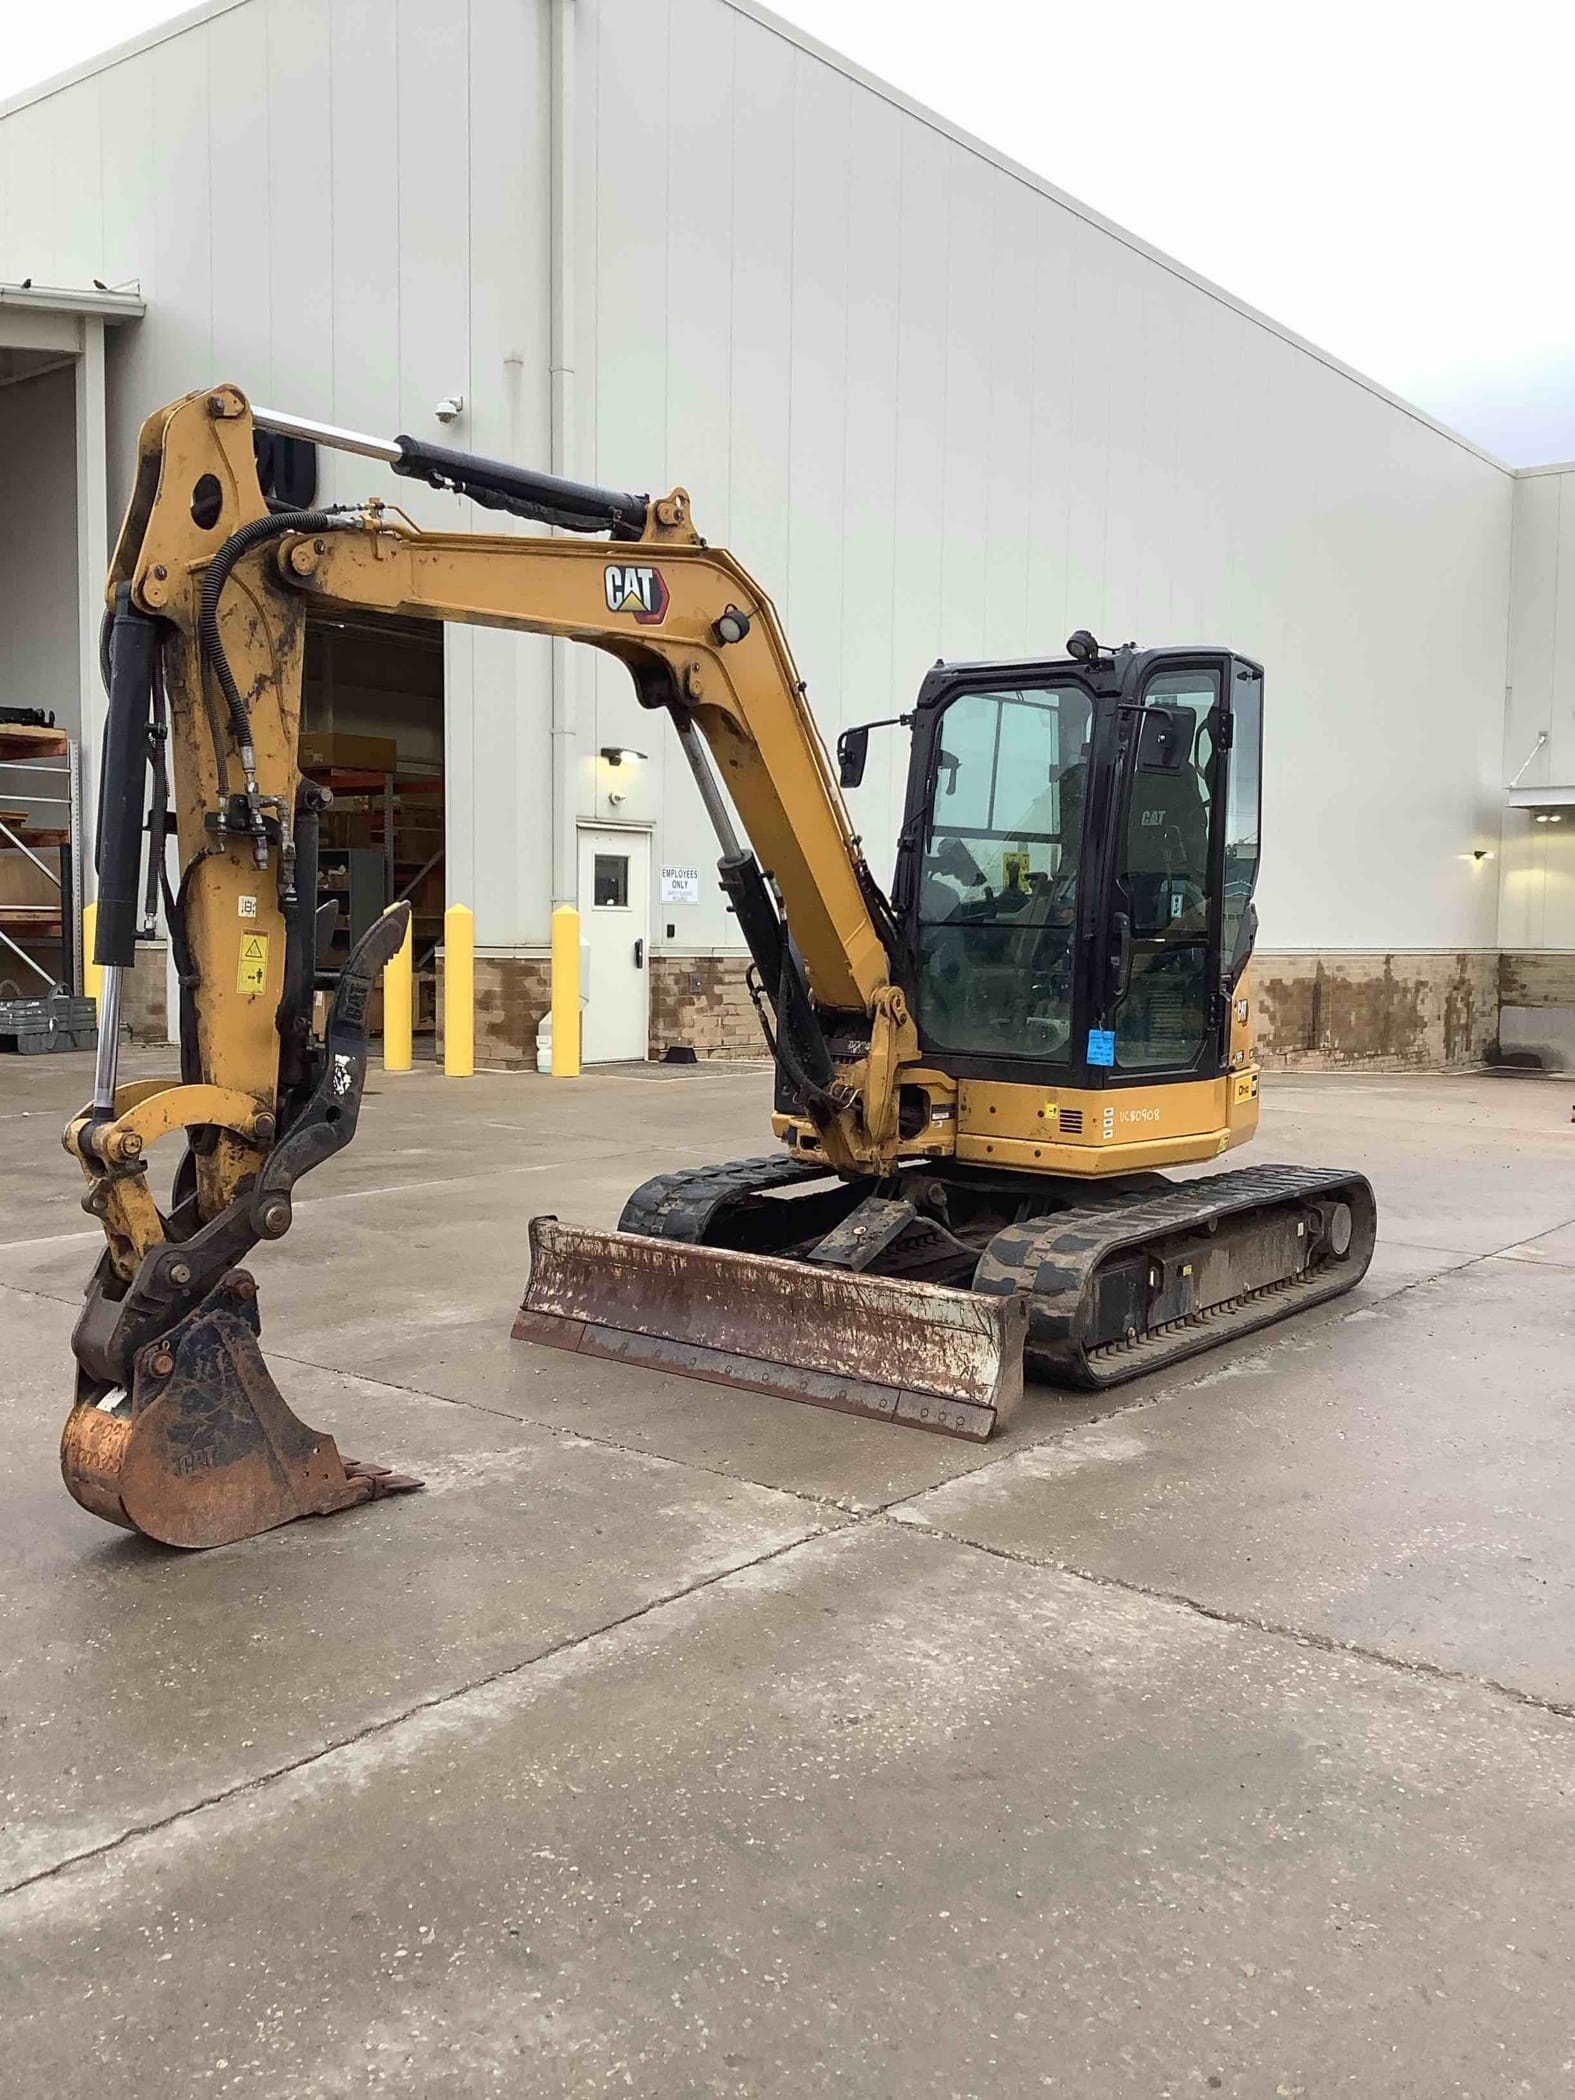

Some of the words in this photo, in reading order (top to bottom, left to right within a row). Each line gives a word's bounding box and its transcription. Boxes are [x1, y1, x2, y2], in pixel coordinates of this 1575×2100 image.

[606, 566, 653, 611] CAT
[1141, 810, 1166, 826] CAT
[662, 868, 698, 879] EMPLOYEES
[671, 879, 688, 889] ONLY
